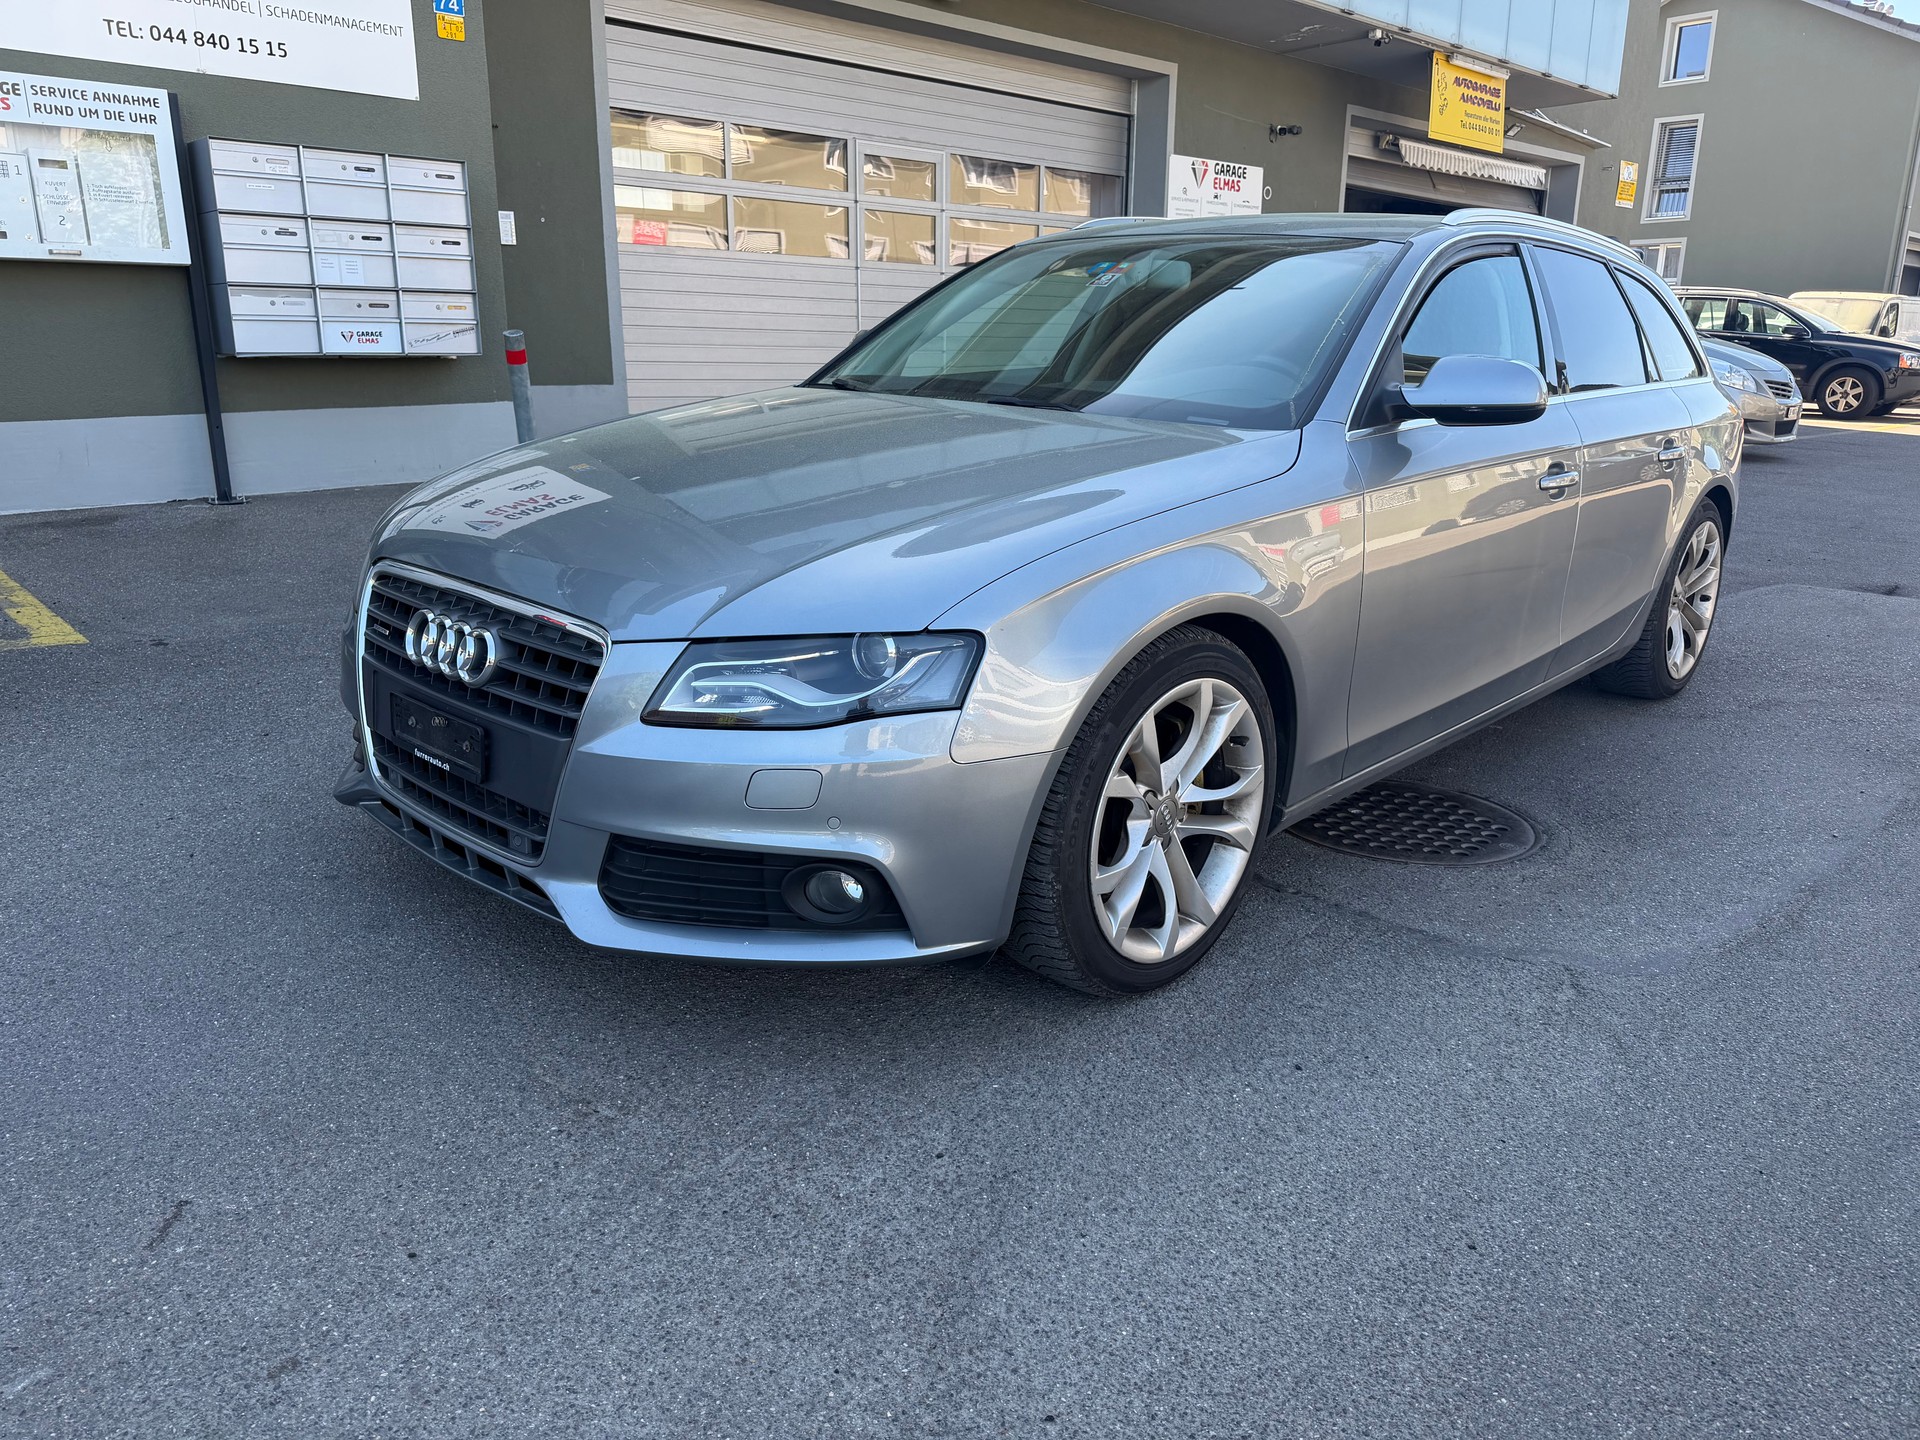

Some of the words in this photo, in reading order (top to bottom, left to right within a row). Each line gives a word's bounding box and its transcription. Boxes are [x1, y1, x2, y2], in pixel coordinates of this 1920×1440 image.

[440, 0, 459, 12] 74
[265, 4, 404, 37] SCHADENMANAGEMENT
[103, 18, 144, 40] TEL:
[149, 24, 188, 45] 044
[193, 31, 230, 51] 840
[237, 36, 260, 55] 15
[265, 41, 288, 58] 15
[30, 84, 88, 101] SERVICE
[93, 91, 160, 109] ANNAHME
[1452, 76, 1501, 99] AUTOGARAGE
[33, 102, 74, 117] RUND
[77, 106, 99, 119] UM
[104, 110, 125, 122] DIE
[129, 113, 158, 125] UHR
[14, 164, 22, 175] 1
[1214, 163, 1247, 179] GARAGE
[1213, 177, 1241, 193] ELMAS
[58, 215, 66, 226] 2
[414, 747, 450, 771] furrerauto.ch
